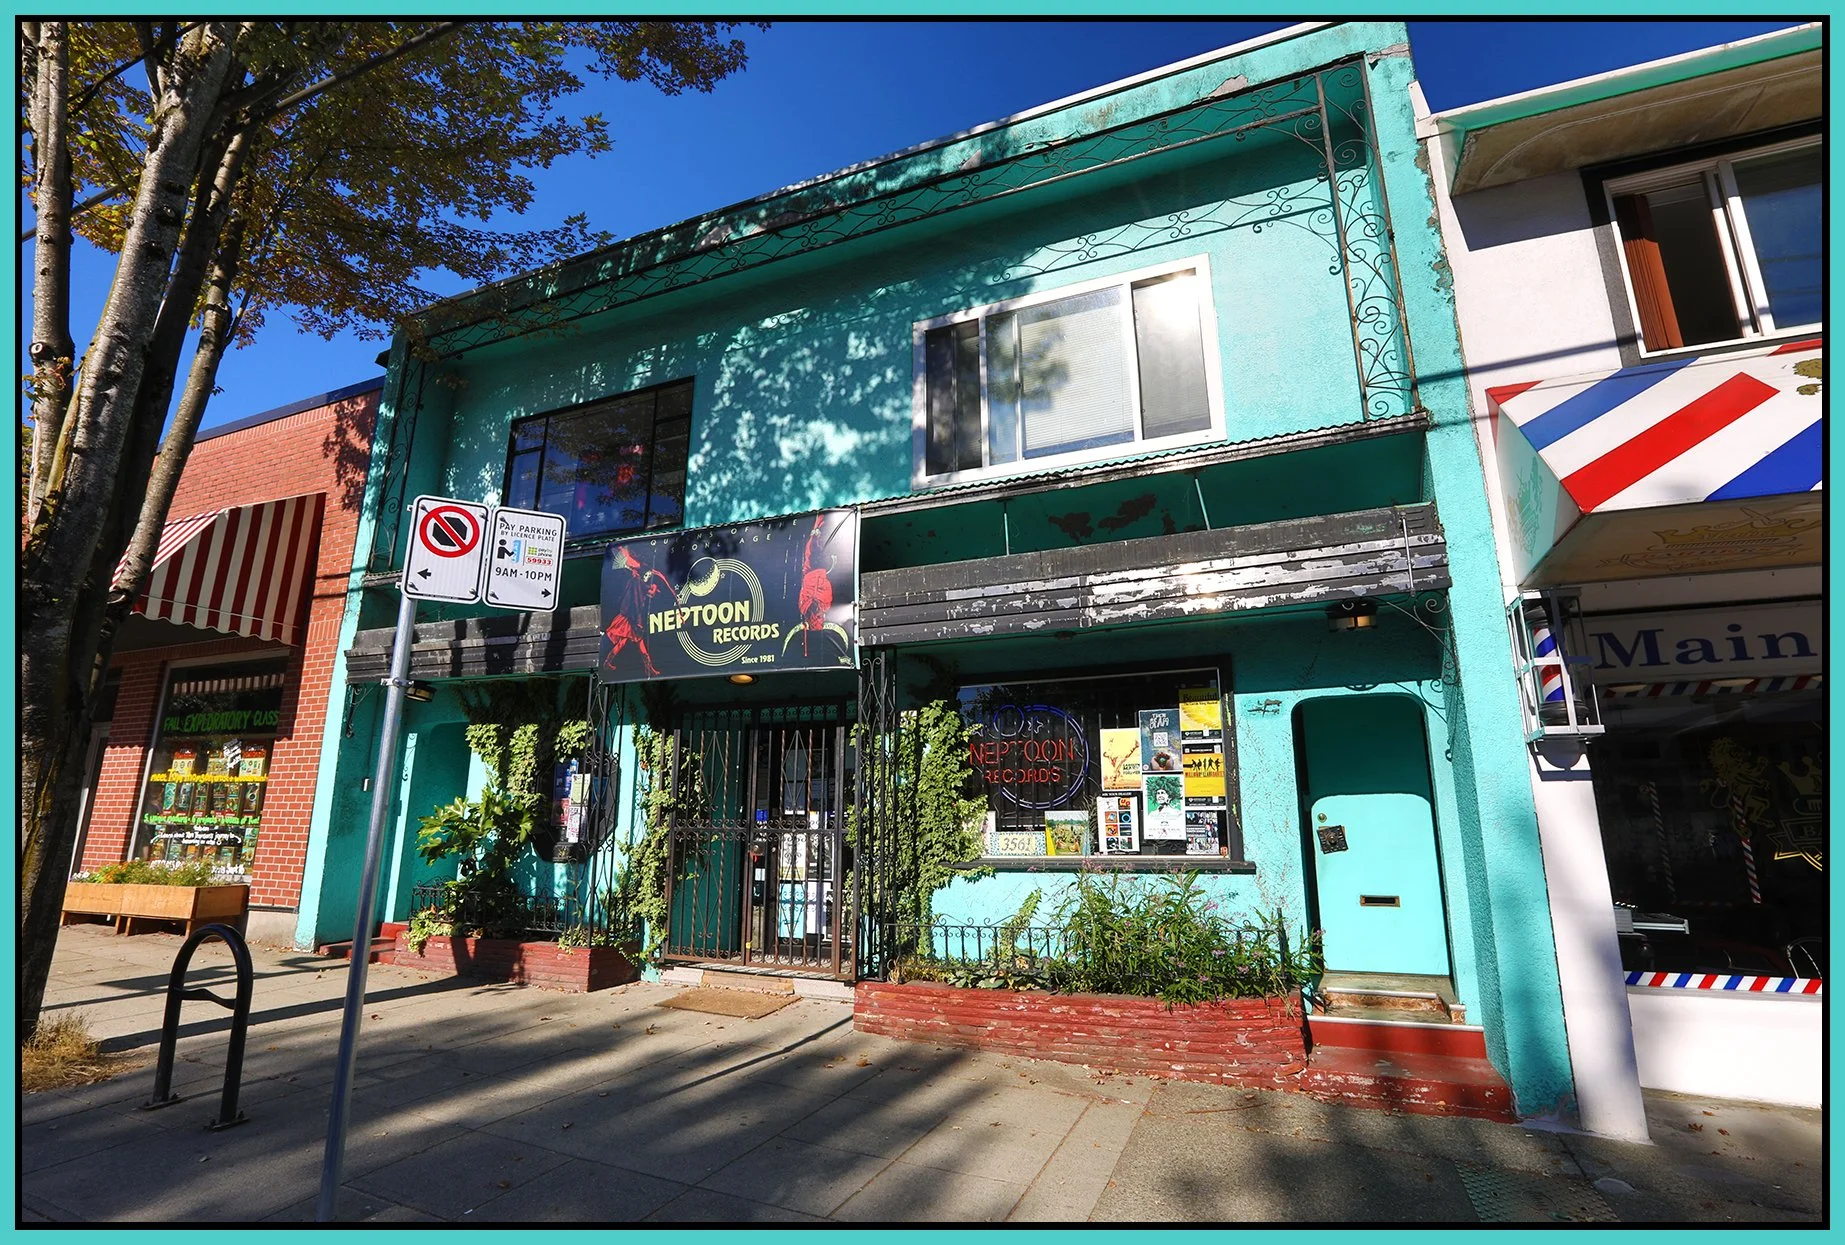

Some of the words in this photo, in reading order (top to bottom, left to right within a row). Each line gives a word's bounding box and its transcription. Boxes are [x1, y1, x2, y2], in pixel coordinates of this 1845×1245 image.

[499, 522, 516, 531] PAY
[519, 525, 557, 536] PARKING
[537, 534, 555, 542] PLATE
[650, 530, 714, 546] QUNS
[738, 533, 772, 545] AGE
[527, 557, 552, 565] 59933
[649, 599, 750, 635] NEPTOON
[713, 622, 780, 645] RECORDS
[1589, 623, 1818, 670] Main
[741, 656, 759, 665] Since
[759, 654, 775, 663] 1981
[163, 716, 181, 731] FALL
[184, 711, 252, 733] EXPLORATORY
[969, 737, 1074, 766] NEPTOON
[984, 766, 1062, 784] RECORDS
[1001, 836, 1031, 852] 3561
